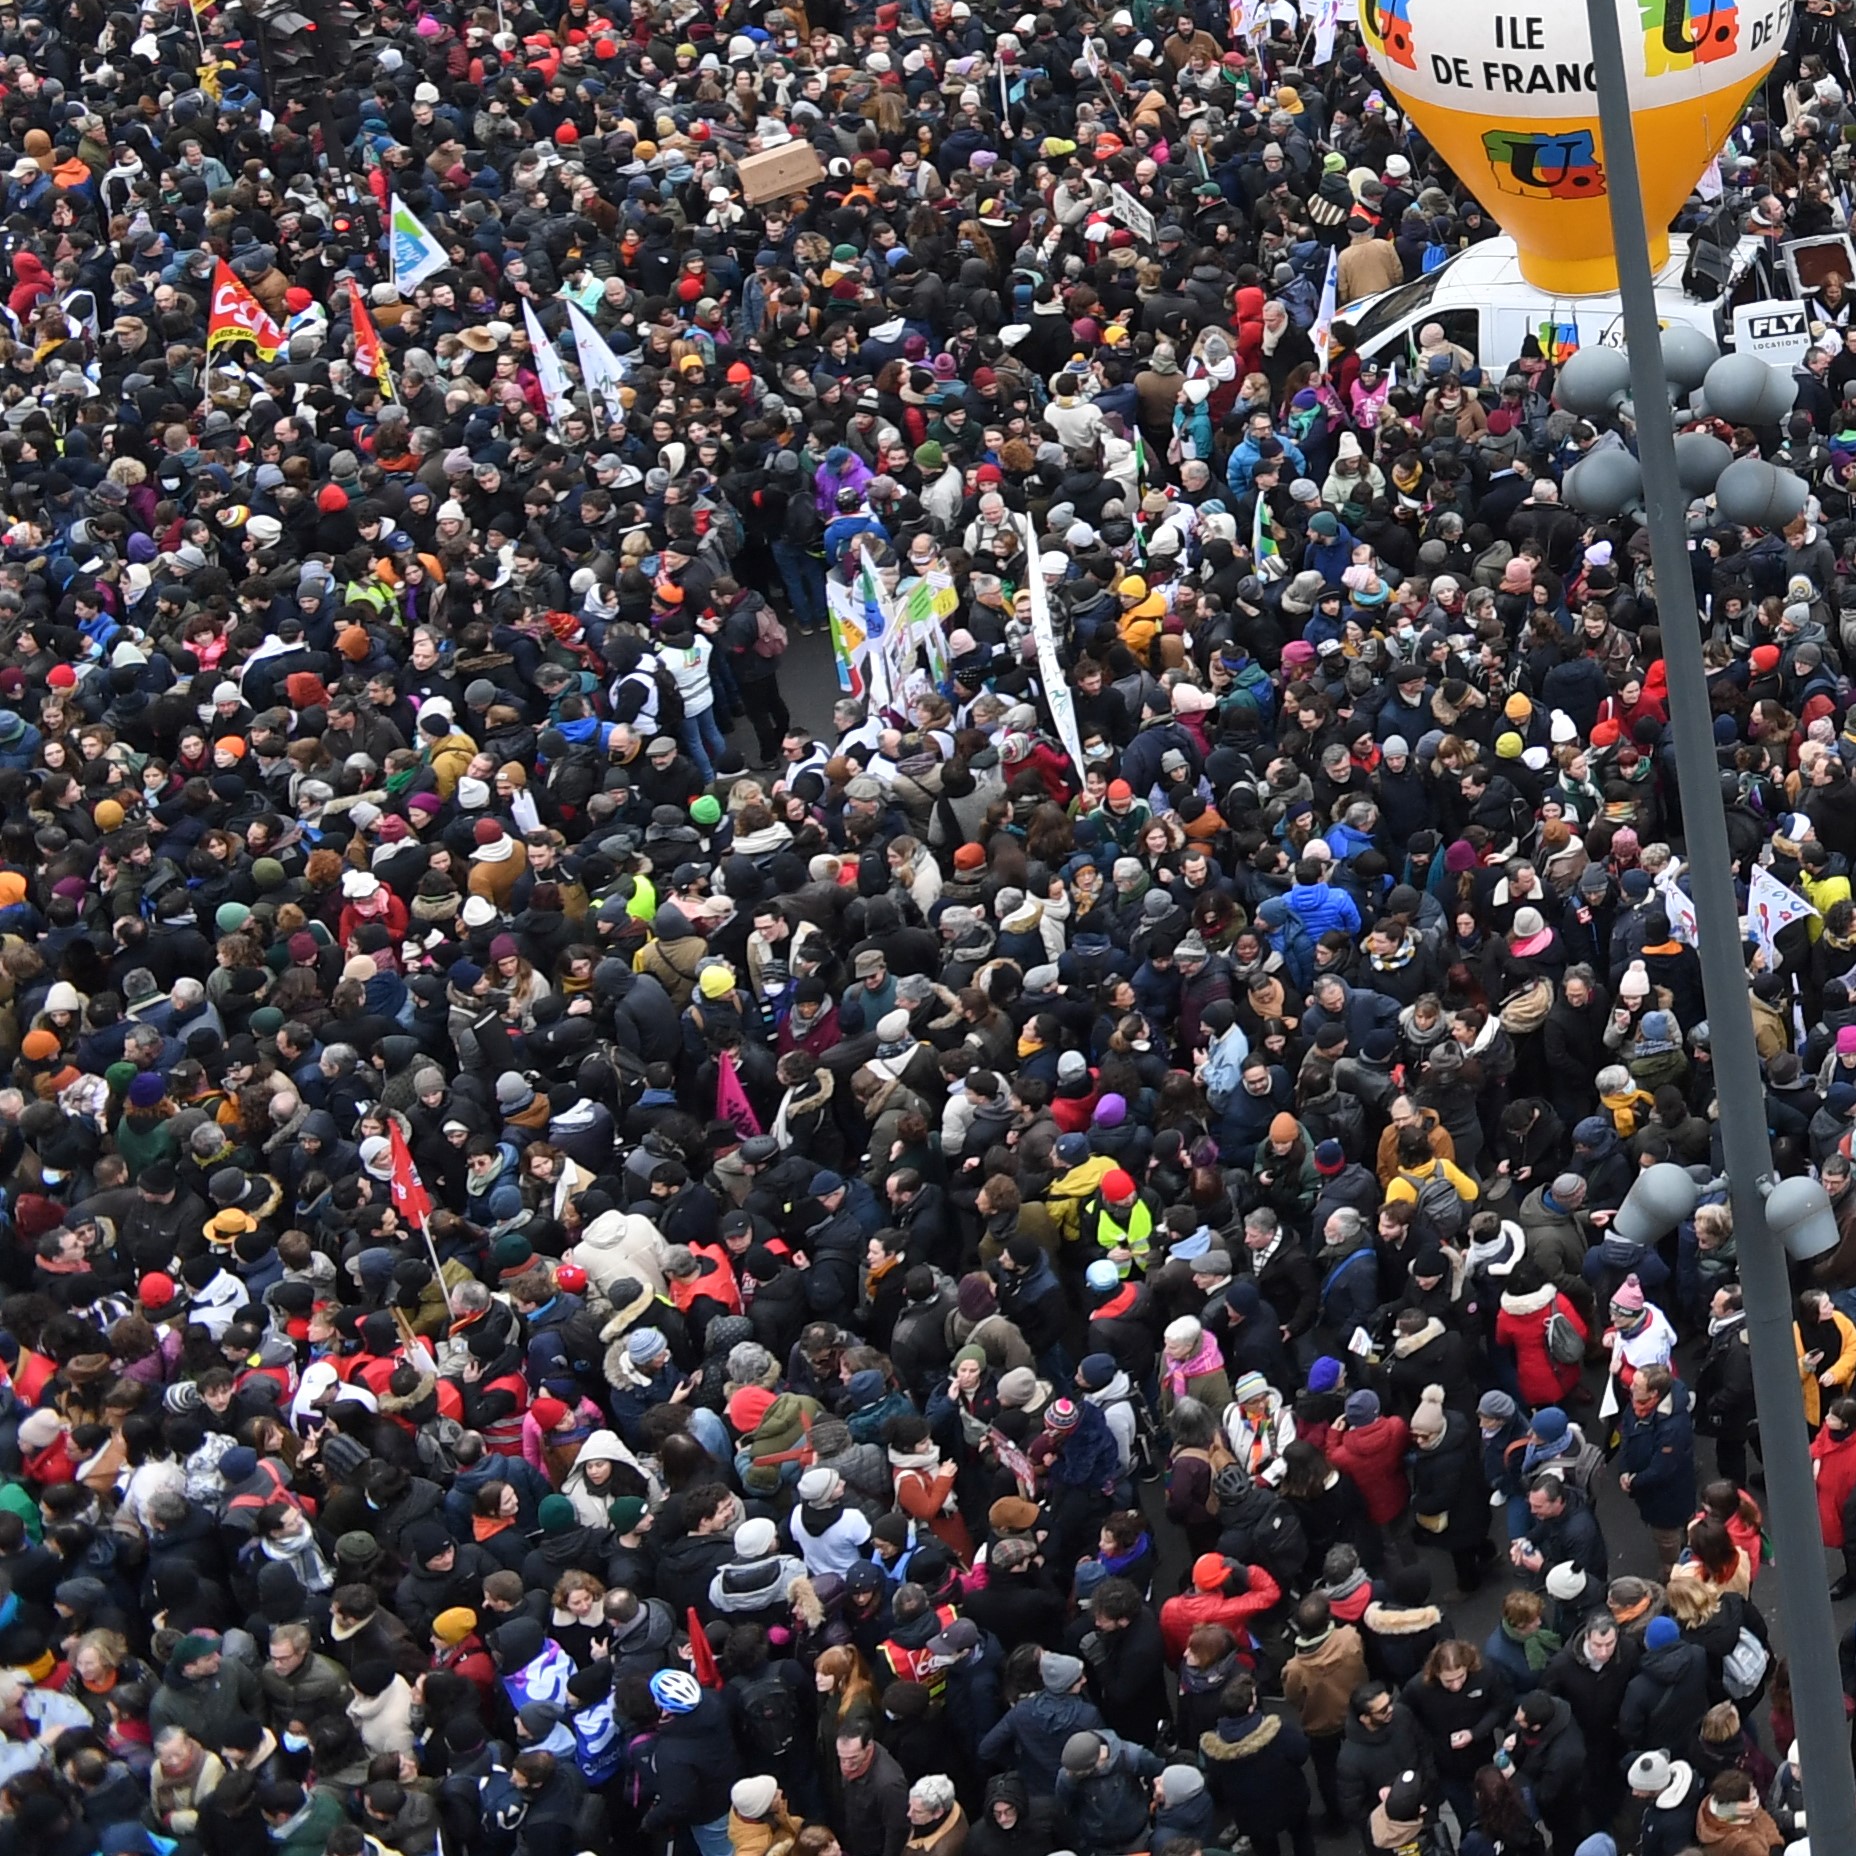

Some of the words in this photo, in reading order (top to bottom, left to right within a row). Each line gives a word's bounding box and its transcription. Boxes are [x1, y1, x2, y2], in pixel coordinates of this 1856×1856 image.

[1495, 16, 1545, 50] ILE
[1751, 14, 1773, 50] DE
[1431, 54, 1474, 89] DE
[1483, 61, 1598, 94] FRANC
[1753, 315, 1804, 338] FLY
[1753, 339, 1799, 350] LOCATION
